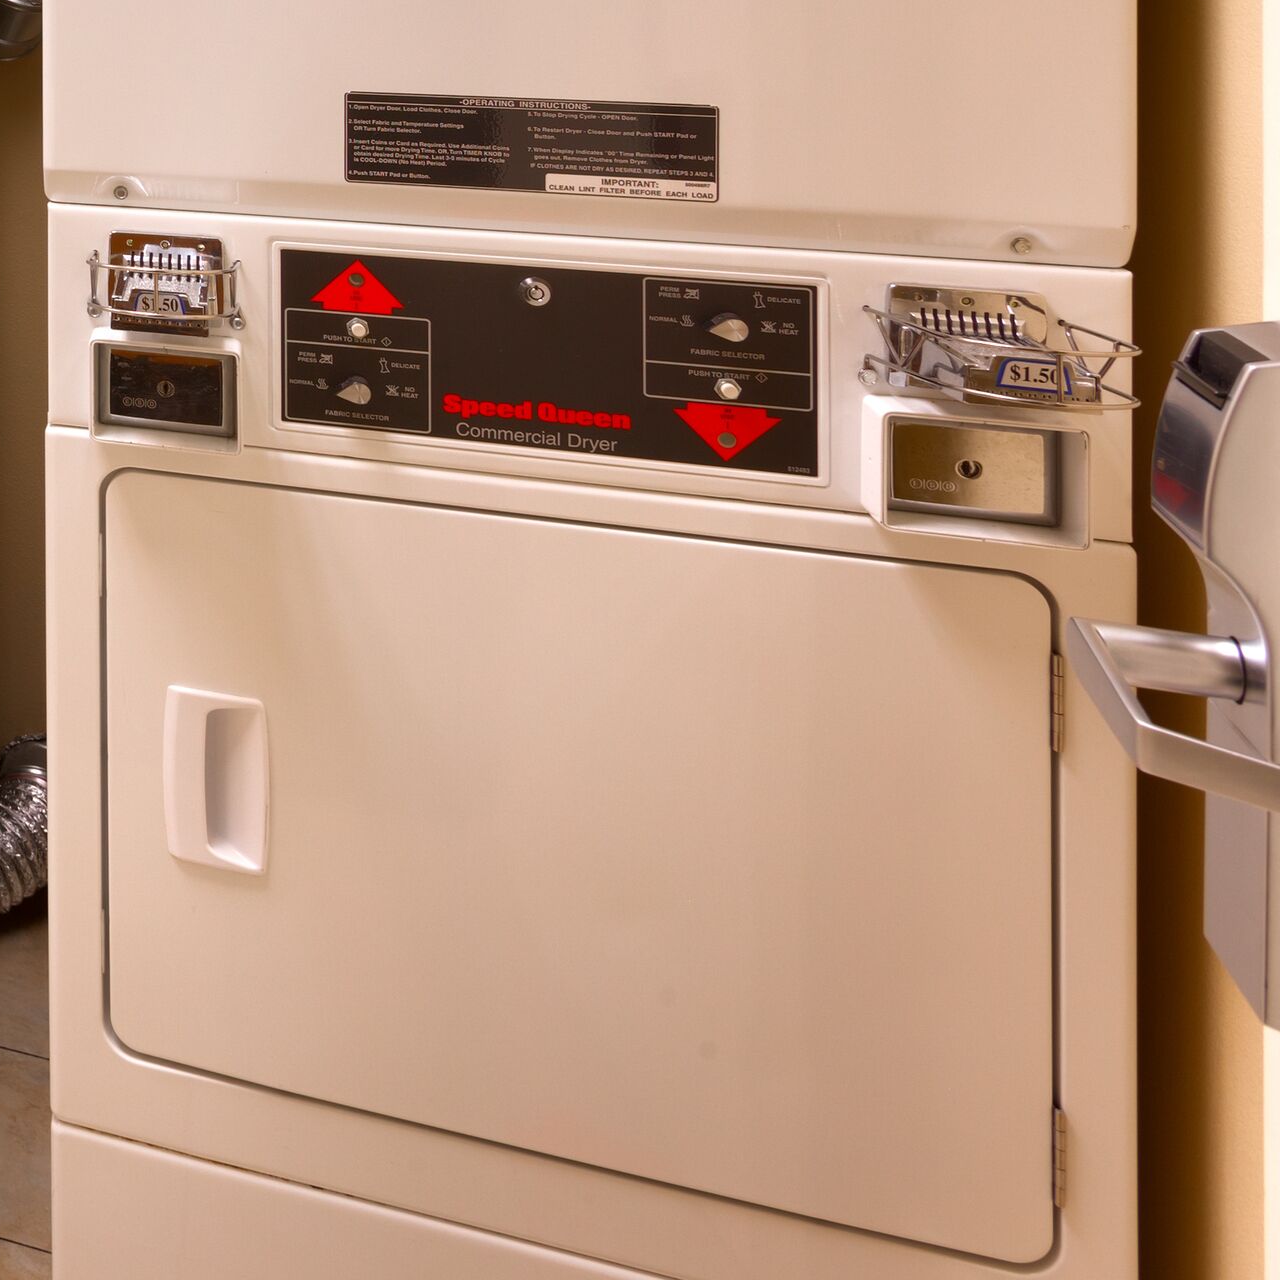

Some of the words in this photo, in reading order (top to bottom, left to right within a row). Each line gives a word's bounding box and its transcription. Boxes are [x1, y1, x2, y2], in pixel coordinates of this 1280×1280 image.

[601, 178, 659, 188] IMPORTANT:
[549, 184, 574, 192] CLEAN
[629, 188, 661, 196] BEFORE
[692, 191, 713, 199] LOAD
[142, 296, 178, 312] $1.50
[767, 297, 801, 305] DELICATE
[649, 315, 678, 323] NORMAL
[691, 348, 720, 357] FABRIC
[721, 351, 765, 360] SELECTOR
[724, 373, 750, 381] START
[325, 409, 350, 418] FABRIC
[352, 412, 389, 421] SELECTOR
[443, 393, 533, 420] Speed
[538, 402, 631, 430] Queen
[456, 422, 561, 446] Commercial
[568, 433, 618, 453] Dryer
